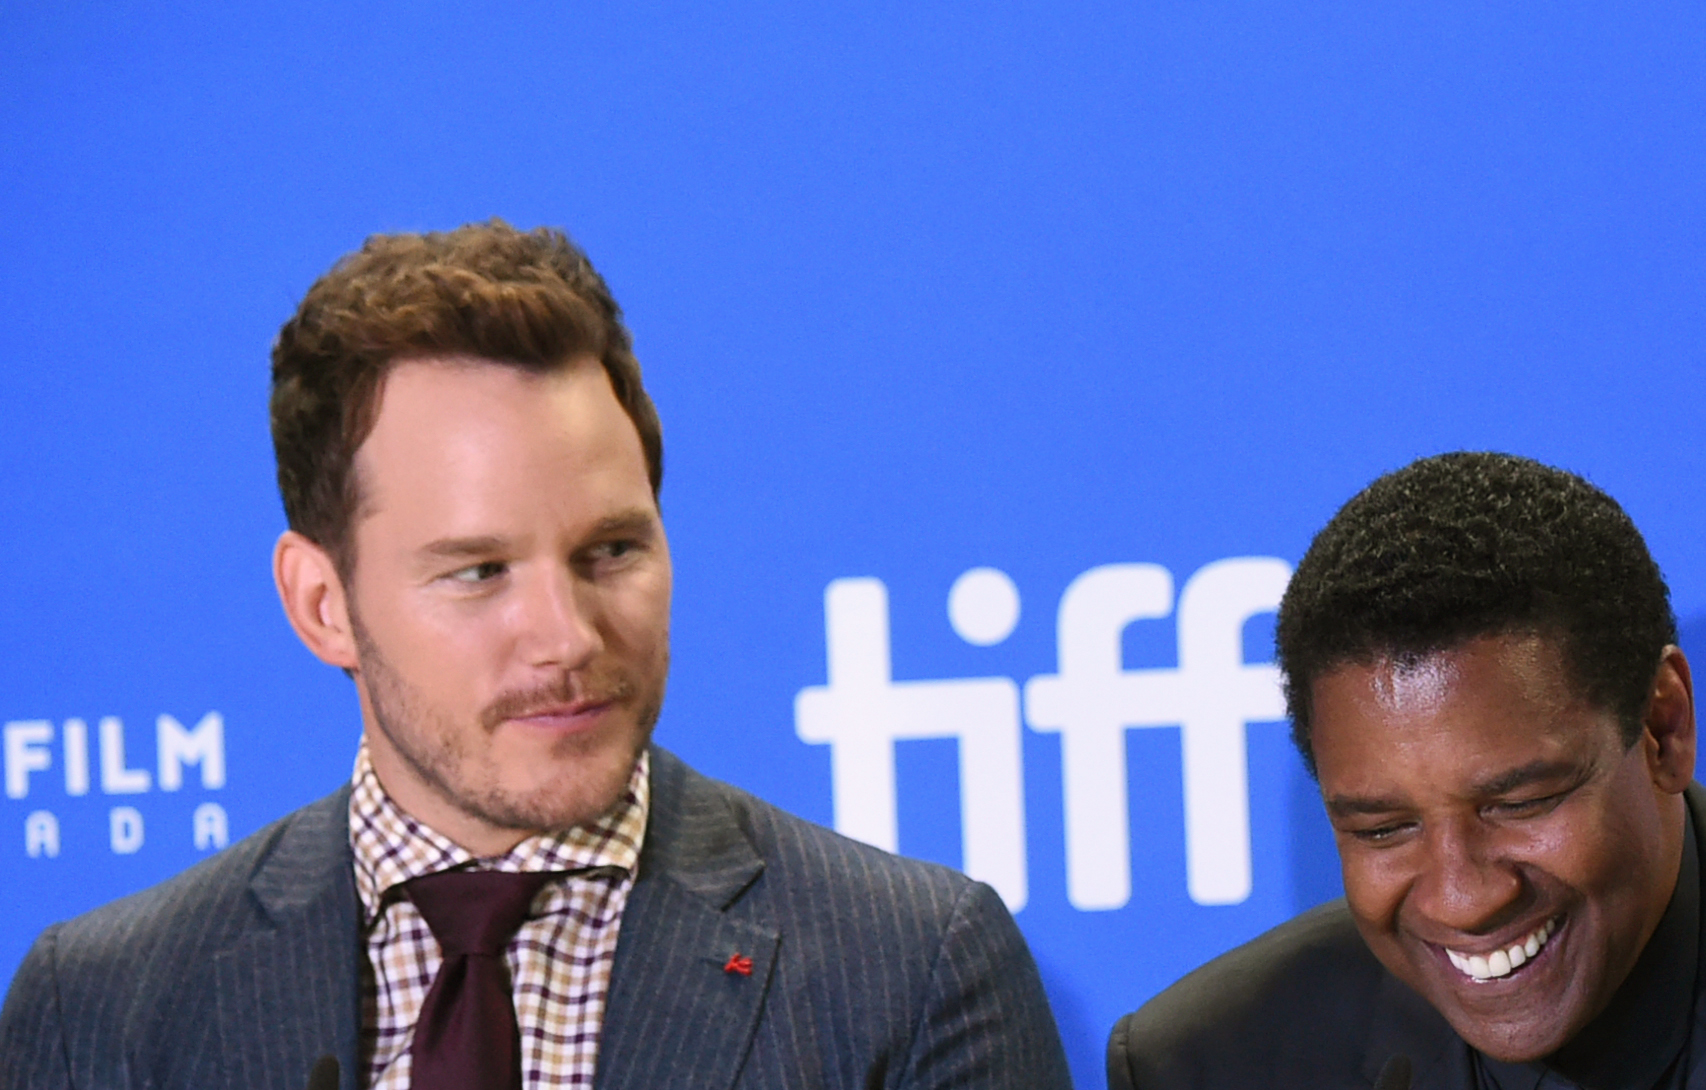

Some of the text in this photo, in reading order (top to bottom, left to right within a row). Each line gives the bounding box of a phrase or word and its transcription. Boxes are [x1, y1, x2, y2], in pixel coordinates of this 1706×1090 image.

[4, 711, 226, 799] FILM
[795, 555, 1293, 912] tiff
[25, 803, 229, 858] ADA
